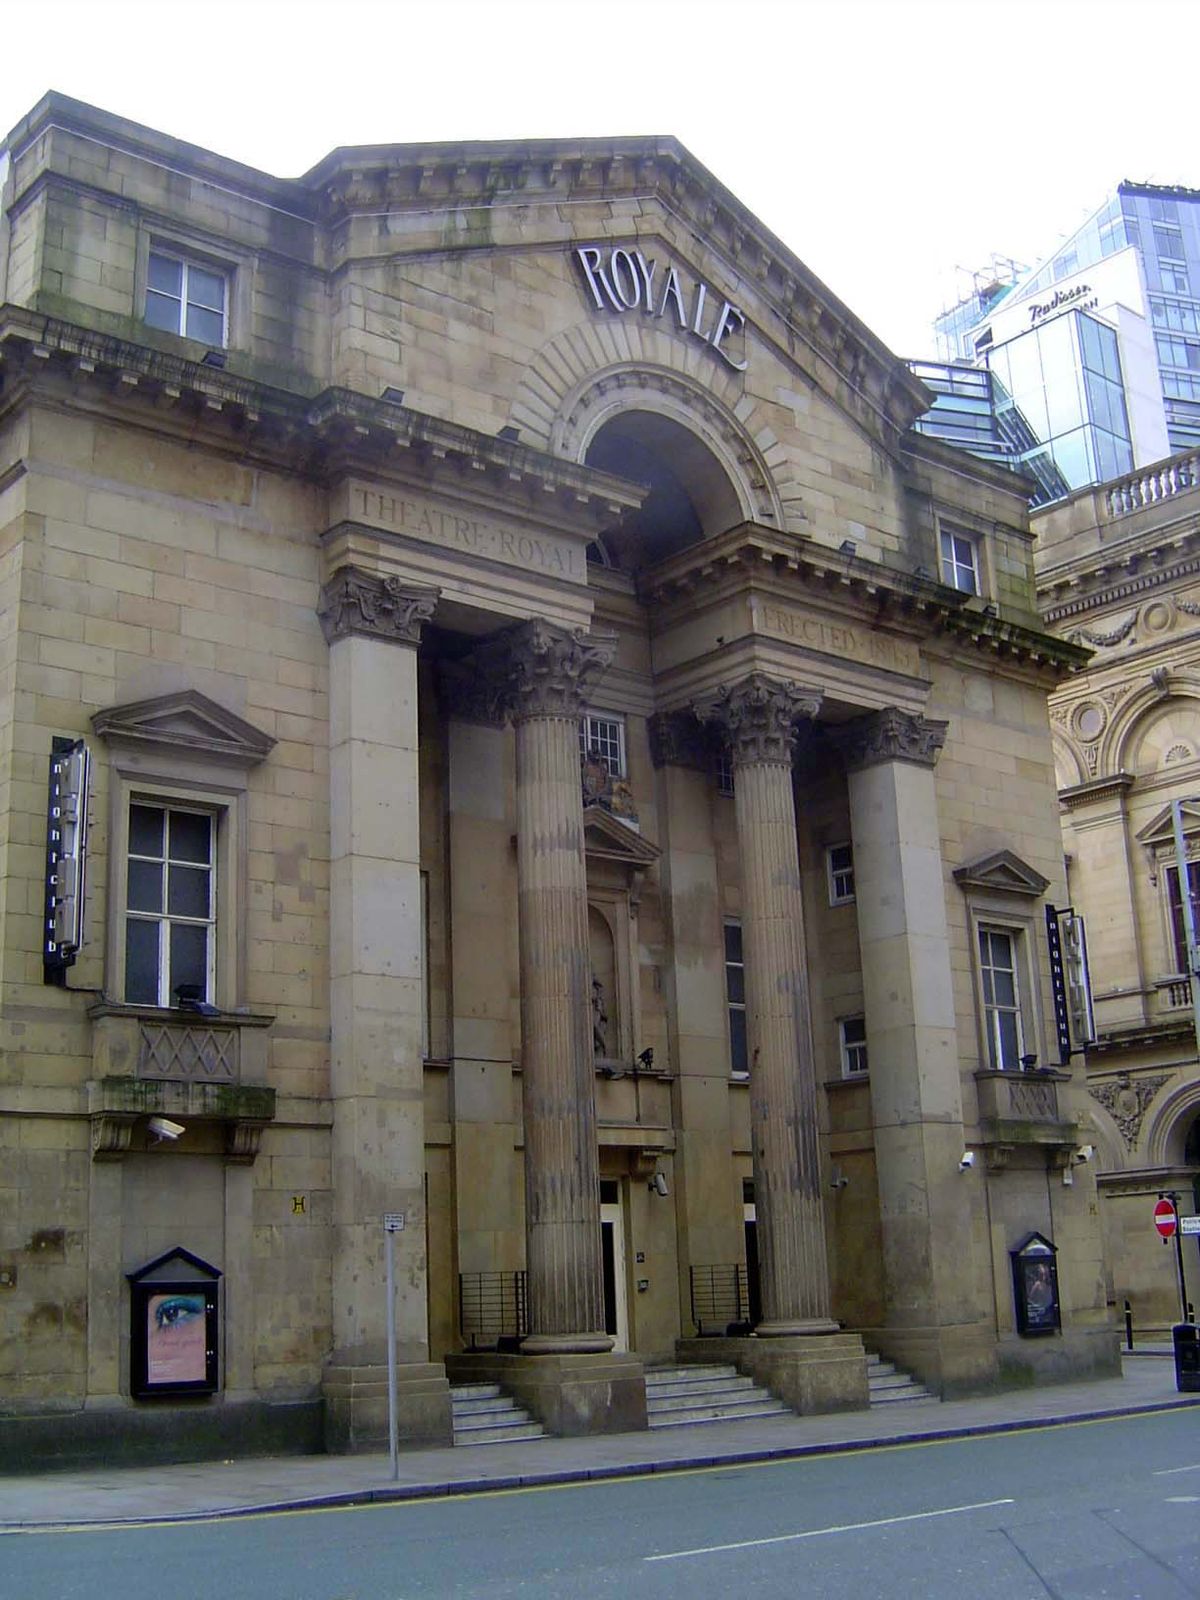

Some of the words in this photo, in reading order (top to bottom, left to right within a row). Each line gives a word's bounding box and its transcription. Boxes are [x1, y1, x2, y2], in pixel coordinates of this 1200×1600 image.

[576, 247, 748, 371] ROYALE
[1028, 285, 1092, 322] Radisson
[355, 488, 489, 553] THEATRE
[498, 527, 584, 577] ROYAL
[1049, 921, 1068, 1046] nightclub
[292, 1196, 305, 1213] H
